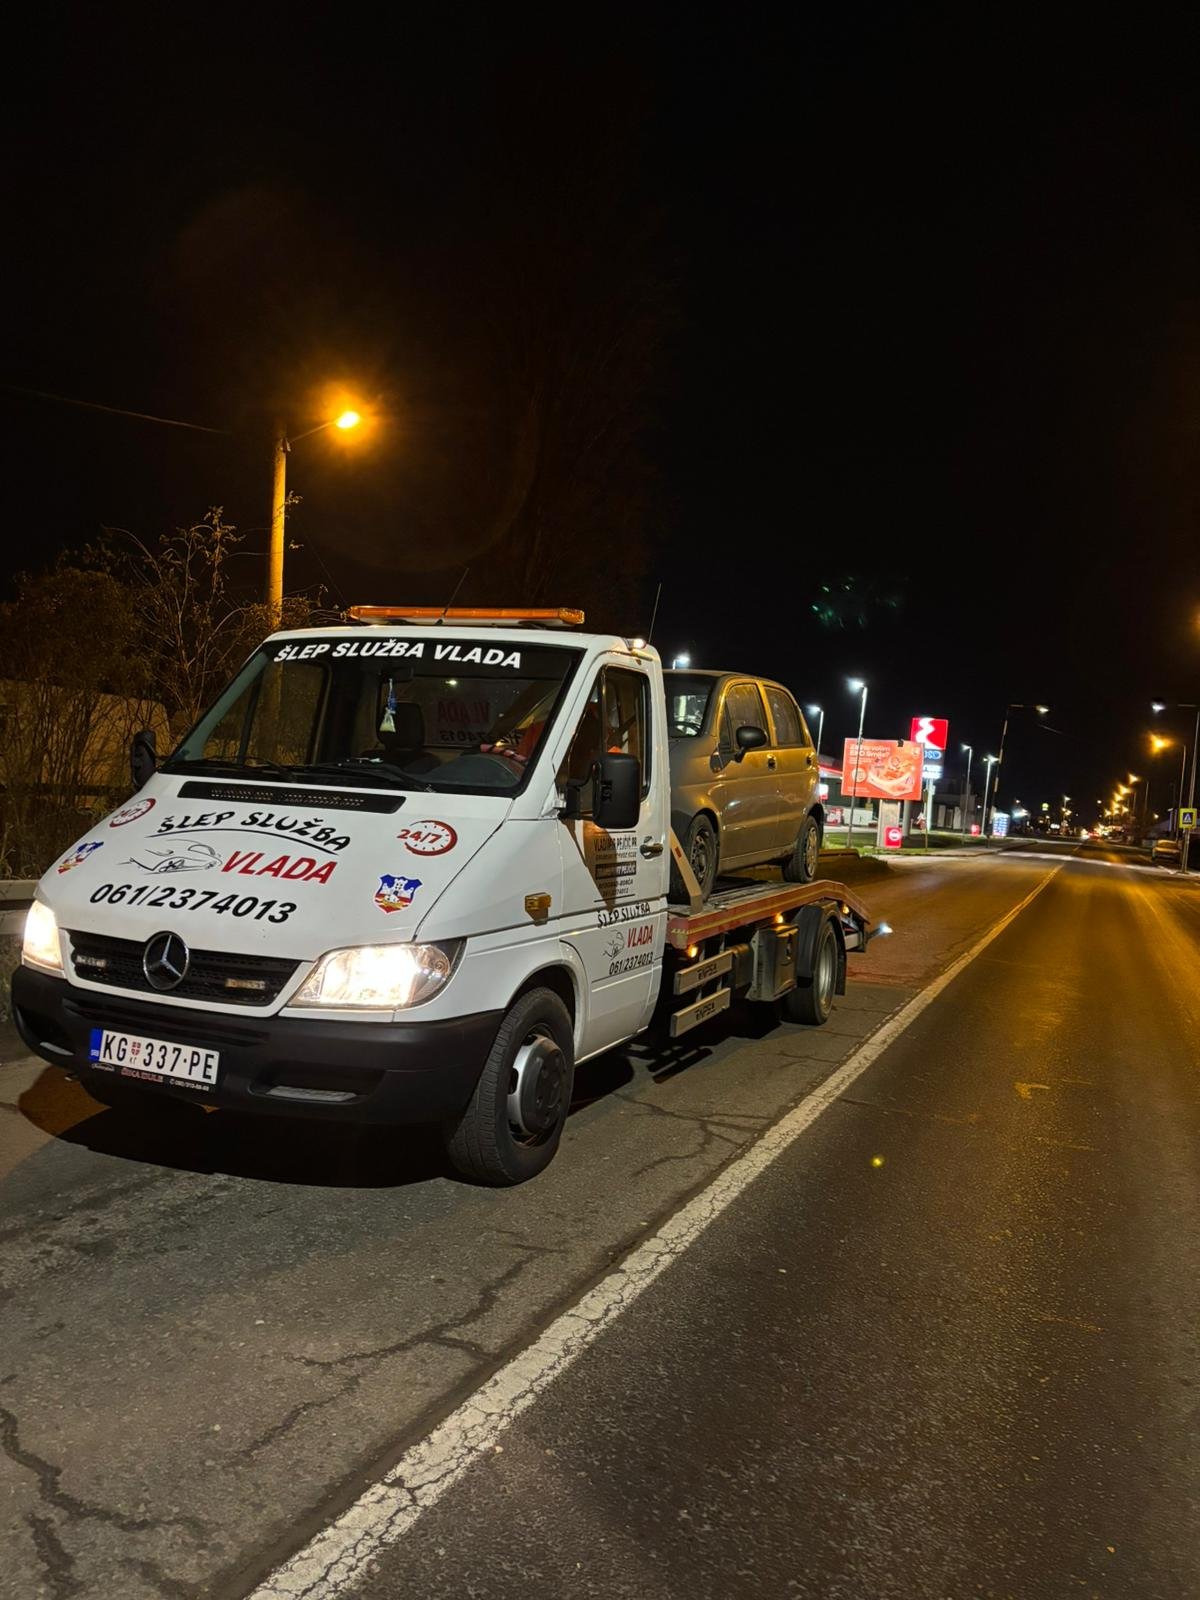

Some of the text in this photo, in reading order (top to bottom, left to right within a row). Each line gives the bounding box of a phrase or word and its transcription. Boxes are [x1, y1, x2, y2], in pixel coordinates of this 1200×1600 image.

[273, 638, 522, 669] ŠLEP SLUŽBA VLADA
[157, 811, 351, 852] ŠLEP SLUŽBA
[396, 829, 442, 844] 24/7
[220, 850, 338, 885] VLADA
[89, 883, 297, 924] 061/2374013
[597, 902, 651, 929] ŠLEP SLUŽBA
[627, 924, 653, 948] VLADA
[103, 1034, 128, 1062] KG
